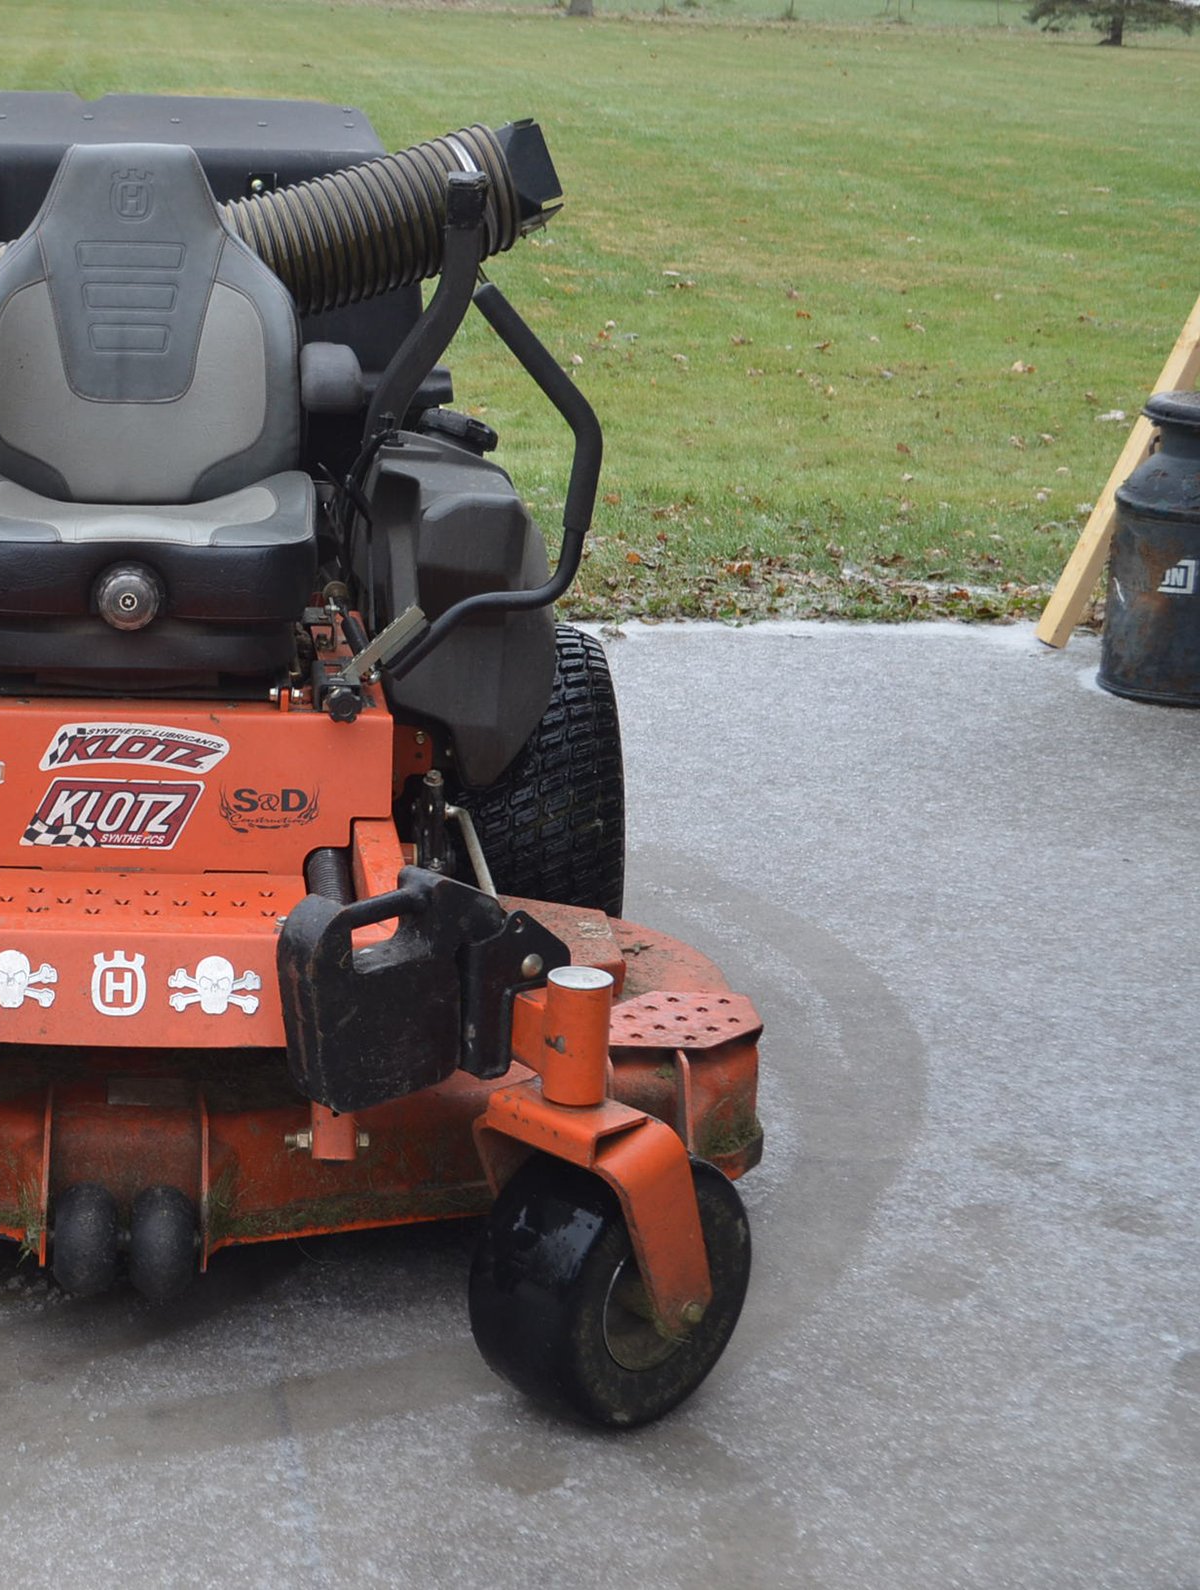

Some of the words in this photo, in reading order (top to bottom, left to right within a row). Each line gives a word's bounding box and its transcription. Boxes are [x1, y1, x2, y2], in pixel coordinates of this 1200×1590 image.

[57, 734, 223, 769] KLOTZ
[86, 727, 152, 737] SYNTHETIC
[153, 730, 225, 749] LUBRICANTS
[45, 790, 187, 833] KLOTZ
[105, 971, 133, 1003] H
